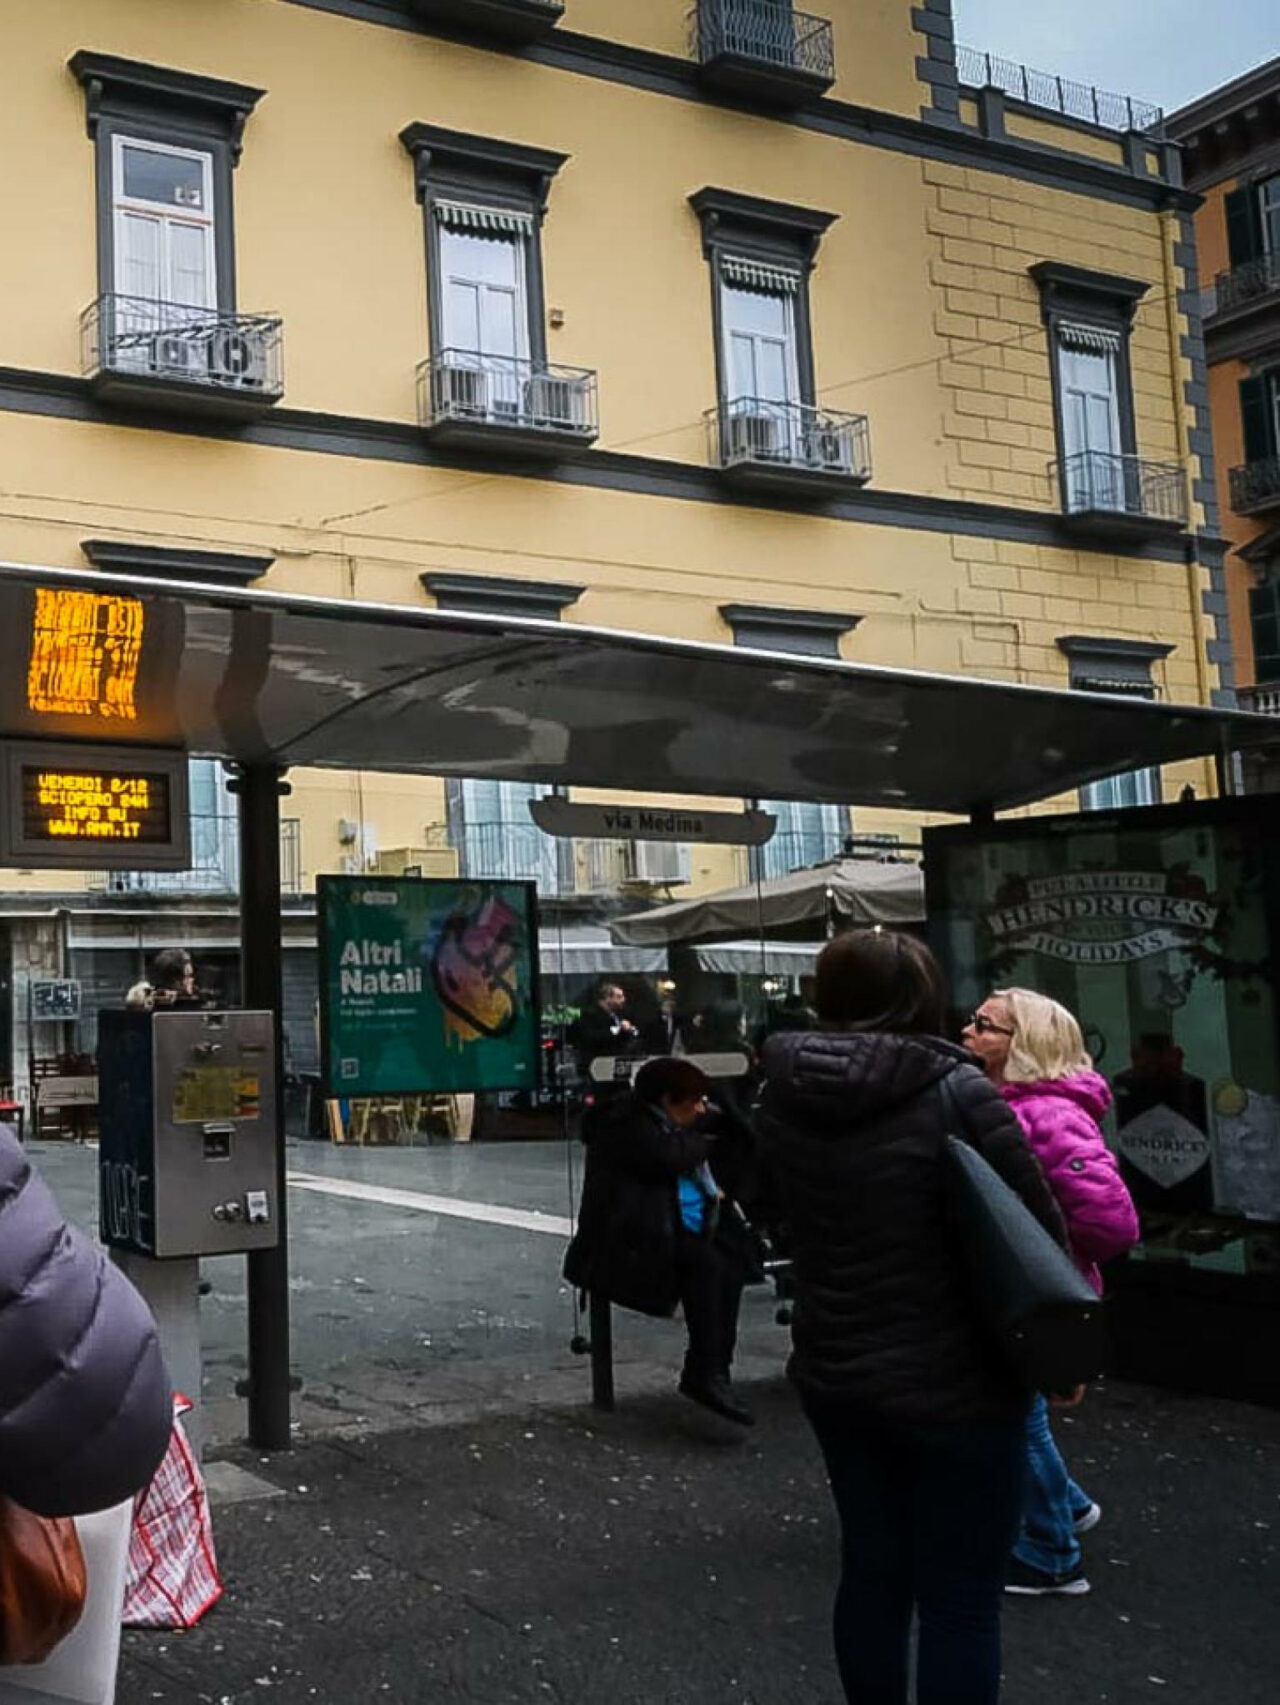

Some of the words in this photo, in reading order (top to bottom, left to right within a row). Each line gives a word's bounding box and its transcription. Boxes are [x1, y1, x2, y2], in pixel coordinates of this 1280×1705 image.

[38, 774, 102, 792] VENERDI
[110, 778, 148, 794] 2/12
[39, 789, 112, 807] SCIOPERO
[120, 793, 149, 808] 24H
[64, 805, 100, 821] INFO
[107, 808, 127, 822] SU
[602, 809, 632, 830] via
[638, 812, 703, 833] Medina
[1000, 897, 1208, 931] HENDRICK'S
[340, 940, 402, 966] Altri
[1034, 932, 1164, 961] HOLIDAYS
[340, 967, 422, 995] Natali
